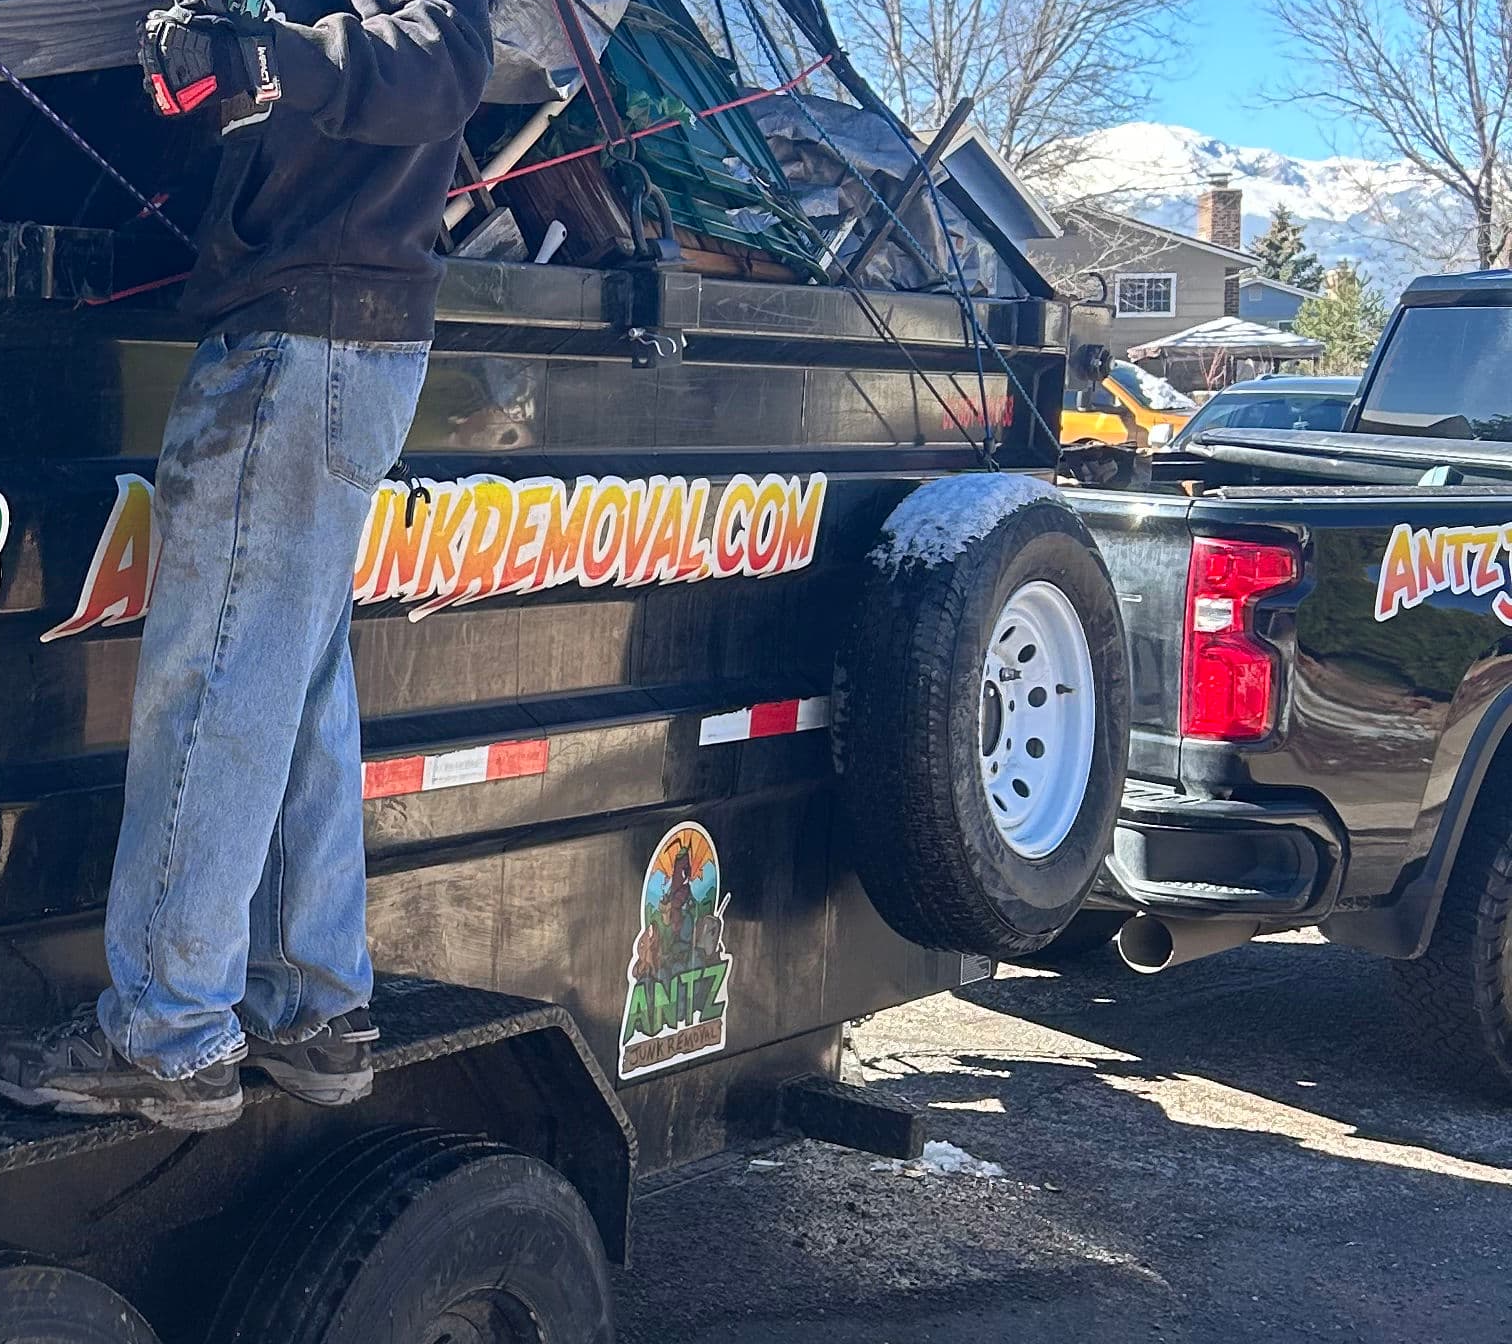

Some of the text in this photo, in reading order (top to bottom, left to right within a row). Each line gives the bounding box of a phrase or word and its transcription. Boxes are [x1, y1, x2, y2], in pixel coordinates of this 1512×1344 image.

[622, 959, 729, 1046] ANTZ
[629, 1026, 718, 1066] JUNK REMOVAL
